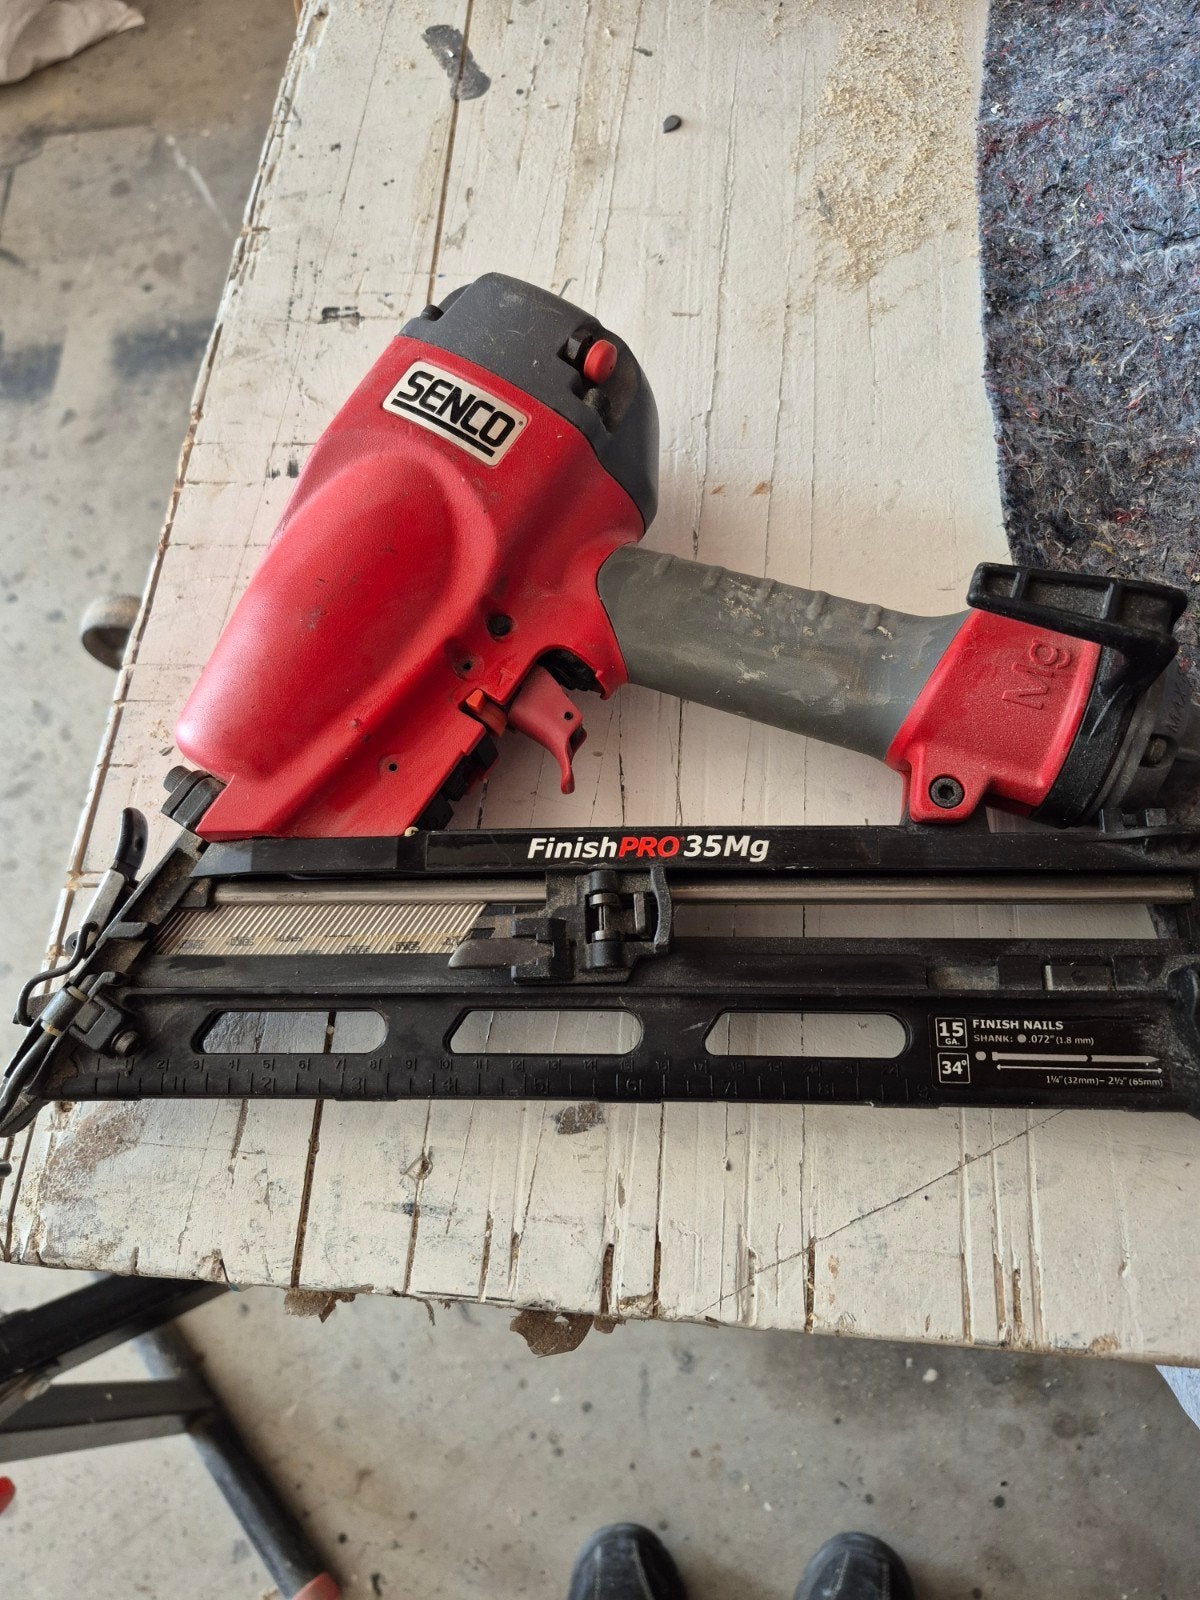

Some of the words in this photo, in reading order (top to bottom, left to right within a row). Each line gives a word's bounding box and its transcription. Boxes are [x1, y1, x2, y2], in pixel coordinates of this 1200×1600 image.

[396, 370, 516, 448] SENCO
[1001, 638, 1073, 711] Mg
[683, 834, 770, 862] 35Mg
[939, 1022, 964, 1037] 15
[972, 1020, 1019, 1030] FINISH
[1023, 1020, 1064, 1030] NAILS
[973, 1034, 1013, 1043] SHANK:
[941, 1060, 967, 1075] 34°
